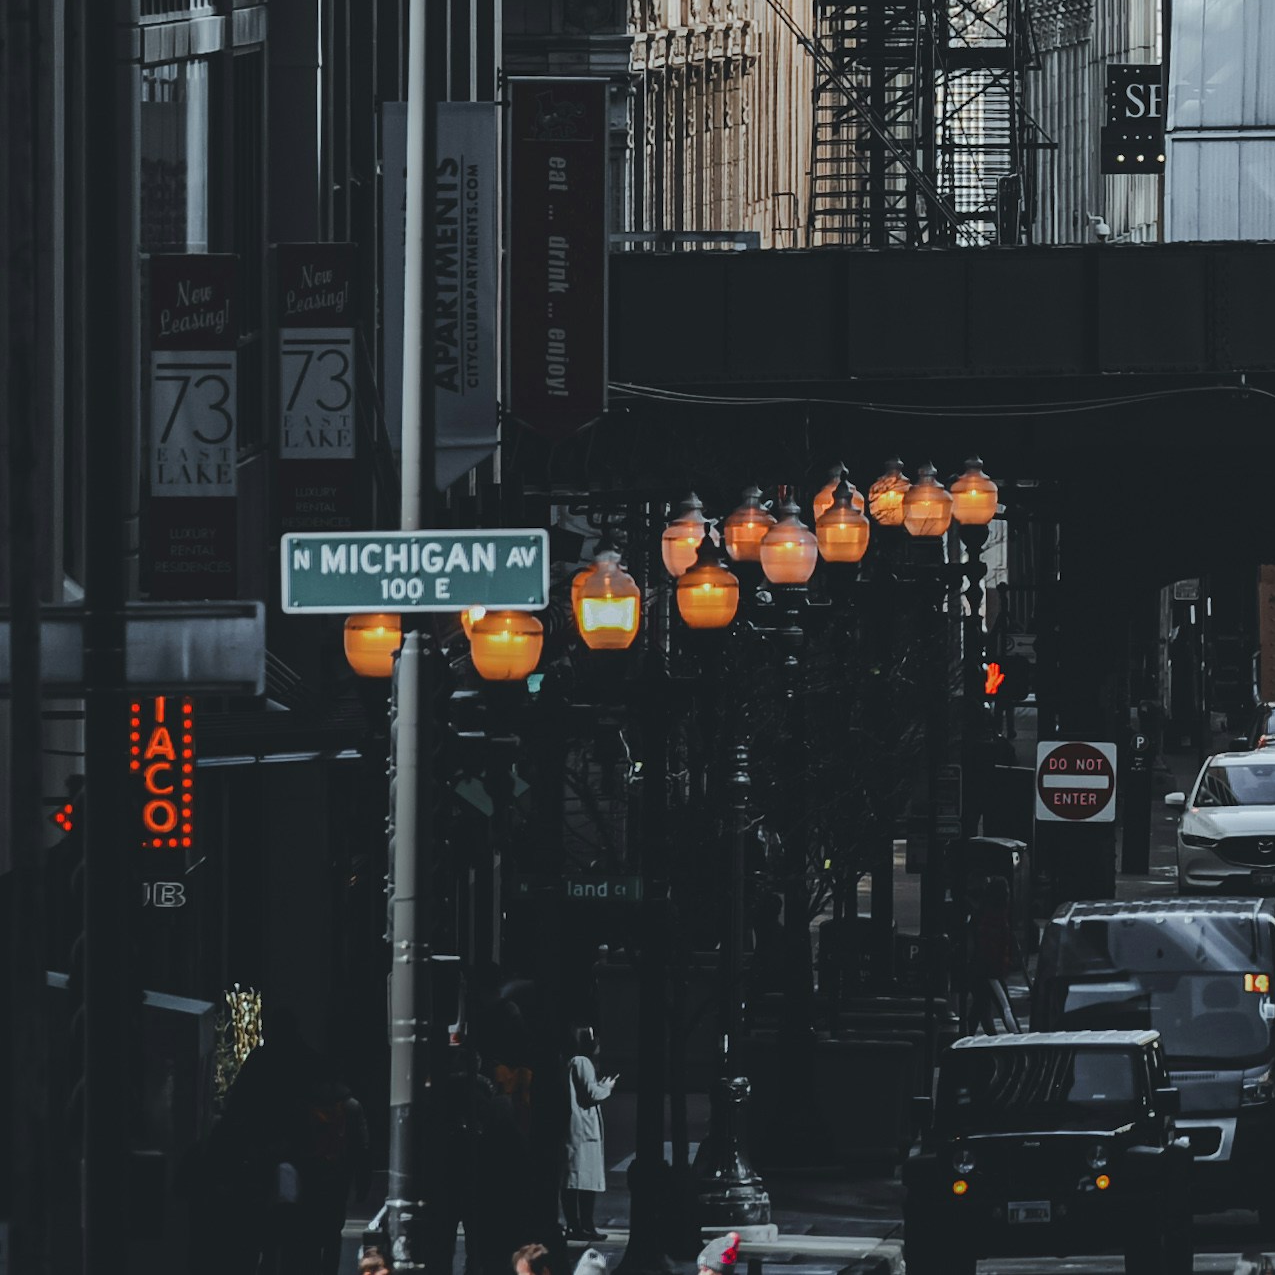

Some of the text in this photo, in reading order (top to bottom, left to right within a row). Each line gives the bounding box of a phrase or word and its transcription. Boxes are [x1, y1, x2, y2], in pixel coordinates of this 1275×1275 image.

[547, 156, 570, 192] eat
[301, 264, 333, 290] Now
[547, 236, 570, 293] drink
[176, 280, 212, 308] Now
[285, 281, 349, 315] Leasing!
[158, 300, 230, 338] Leasing!
[545, 328, 571, 397] enjoy!
[282, 349, 352, 412] 73
[155, 374, 233, 445] 73
[284, 415, 350, 428] EAST
[284, 429, 351, 447] LAKE
[157, 448, 231, 462] EAST
[158, 464, 232, 485] LAKE
[294, 542, 538, 575] N MICHIGAN AV
[381, 577, 451, 600] 100 E
[1137, 736, 1145, 749] P
[1049, 758, 1104, 771] DO NOT
[1053, 793, 1097, 806] ENTER
